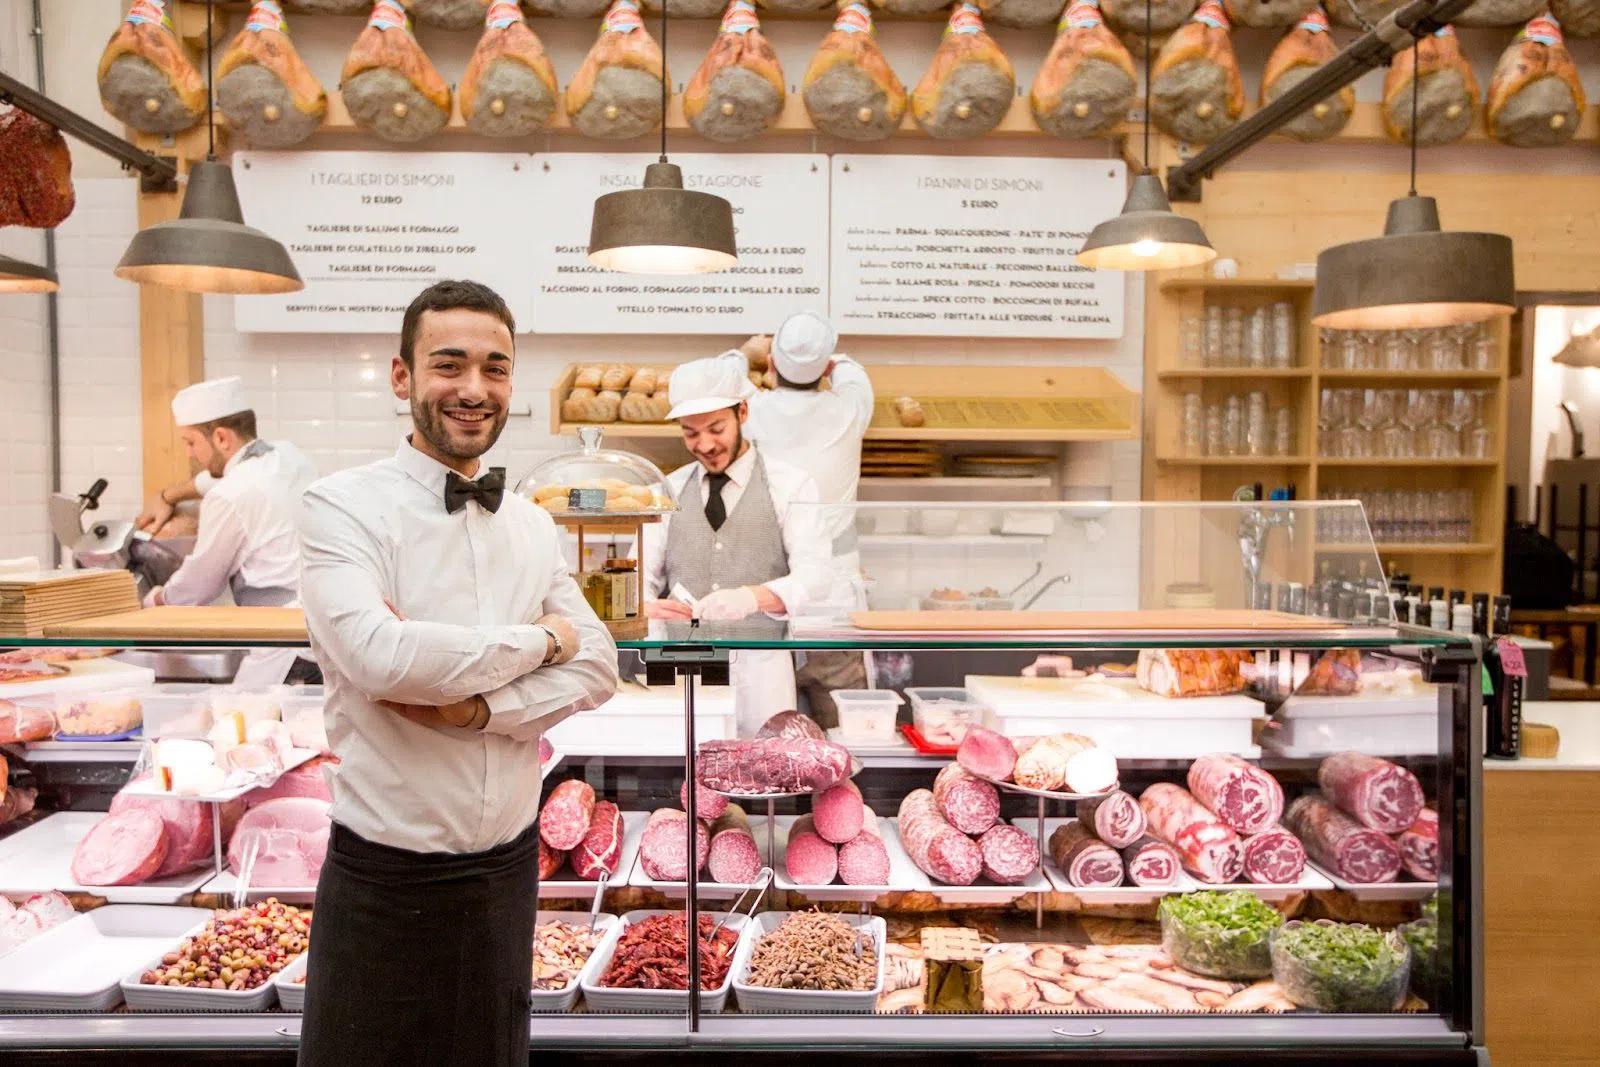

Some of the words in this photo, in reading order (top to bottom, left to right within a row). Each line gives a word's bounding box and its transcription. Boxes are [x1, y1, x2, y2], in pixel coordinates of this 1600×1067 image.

[311, 173, 316, 186] I
[318, 172, 382, 187] TAGLIERI
[384, 172, 400, 187] DI
[402, 173, 454, 186] SIMONI
[600, 175, 643, 186] INSAL
[688, 175, 762, 187] STAGIONE
[917, 176, 922, 189] I
[925, 177, 971, 189] PANINI
[974, 178, 988, 190] DI
[991, 178, 1043, 191] SIMONI
[374, 195, 402, 205] EURO
[971, 199, 998, 209] EURO
[307, 224, 350, 233] TAGLIERE
[353, 224, 363, 233] DI
[365, 225, 400, 233] SALUMI
[402, 225, 406, 233] E
[410, 225, 459, 234] FORMAGGI
[1047, 230, 1056, 239] DI
[1059, 231, 1088, 240] POMO
[291, 244, 333, 253] TAGLIERE
[336, 244, 346, 253] DI
[348, 244, 402, 254] CULATELLO
[404, 245, 414, 254] DI
[456, 245, 476, 254] DOP
[556, 245, 590, 254] ROAST
[736, 246, 770, 255] UCOLA
[781, 247, 805, 255] EURO
[916, 244, 970, 254] PORCHETTA
[973, 246, 1016, 255] ARROSTO
[1023, 246, 1053, 255] FRUTTI
[1056, 247, 1065, 256] DI
[1067, 247, 1082, 257] CA
[329, 264, 371, 273] TAGLIERE
[375, 264, 384, 273] DI
[386, 265, 435, 273] FORMAGGI
[730, 266, 768, 275] RUCOLA
[778, 266, 803, 275] EURO
[891, 260, 923, 270] COTTO
[926, 262, 936, 270] AL
[939, 262, 987, 271] NATURALE
[996, 263, 1043, 272] PECORINO
[896, 278, 932, 286] SALAME
[935, 278, 959, 287] ROSA
[1009, 280, 1059, 289] POMODORI
[1062, 281, 1094, 290] SECCHI
[541, 285, 589, 294] TACCHINO
[592, 285, 602, 294] AL
[643, 285, 700, 294] FORMAGGIO
[702, 285, 729, 294] DIETA
[732, 285, 736, 295] E
[739, 286, 784, 295] INSALATA
[795, 286, 820, 295] EURO
[923, 295, 951, 304] SPECK
[954, 295, 986, 305] COTTO
[993, 296, 1051, 306] BOCCONCINI
[1053, 297, 1062, 306] DI
[1065, 298, 1099, 307] BUFALA
[617, 305, 655, 314] VITELLO
[658, 305, 703, 314] TONNATO
[719, 305, 744, 314] EURO
[878, 311, 936, 320] STRACCHINO
[944, 312, 986, 321] FRITTATA
[989, 313, 1009, 322] ALLE
